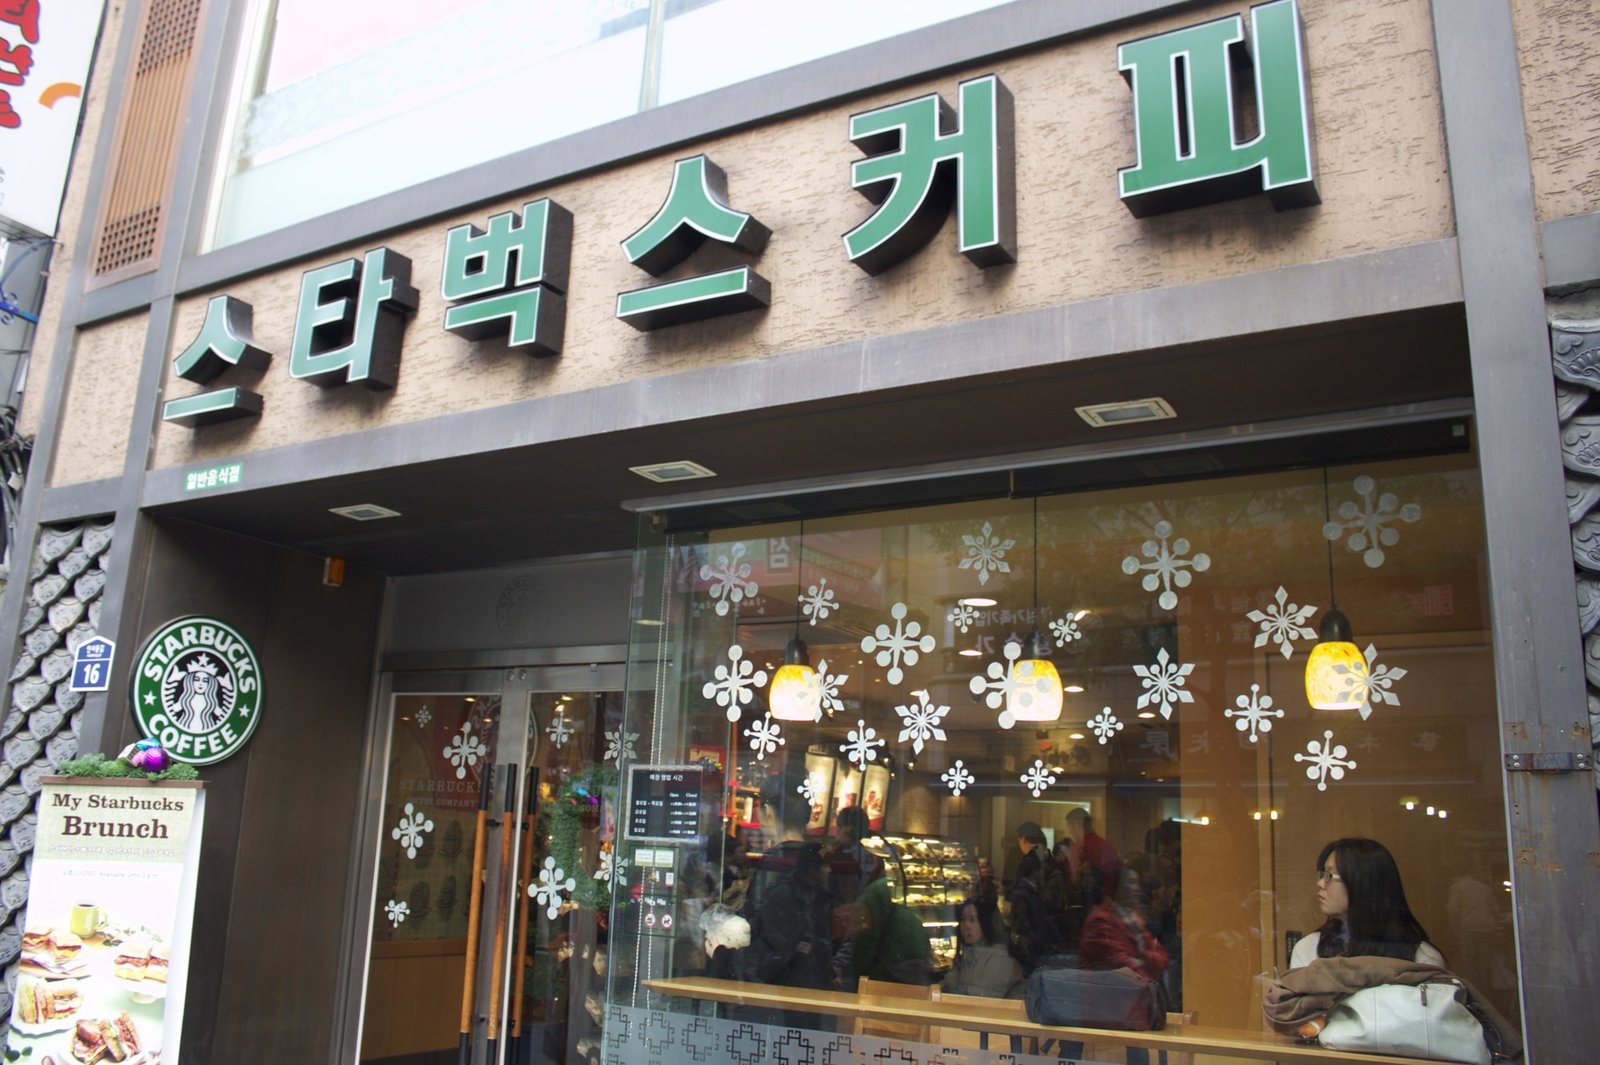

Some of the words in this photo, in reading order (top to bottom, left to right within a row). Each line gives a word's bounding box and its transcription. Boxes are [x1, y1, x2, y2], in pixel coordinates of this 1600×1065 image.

[186, 465, 241, 490] 일반음식점
[144, 625, 256, 694] STARBUCKS
[83, 663, 101, 684] 16
[149, 713, 238, 757] COFFEE
[52, 793, 82, 811] My
[88, 794, 184, 812] Starbucks
[61, 815, 169, 840] Brunch
